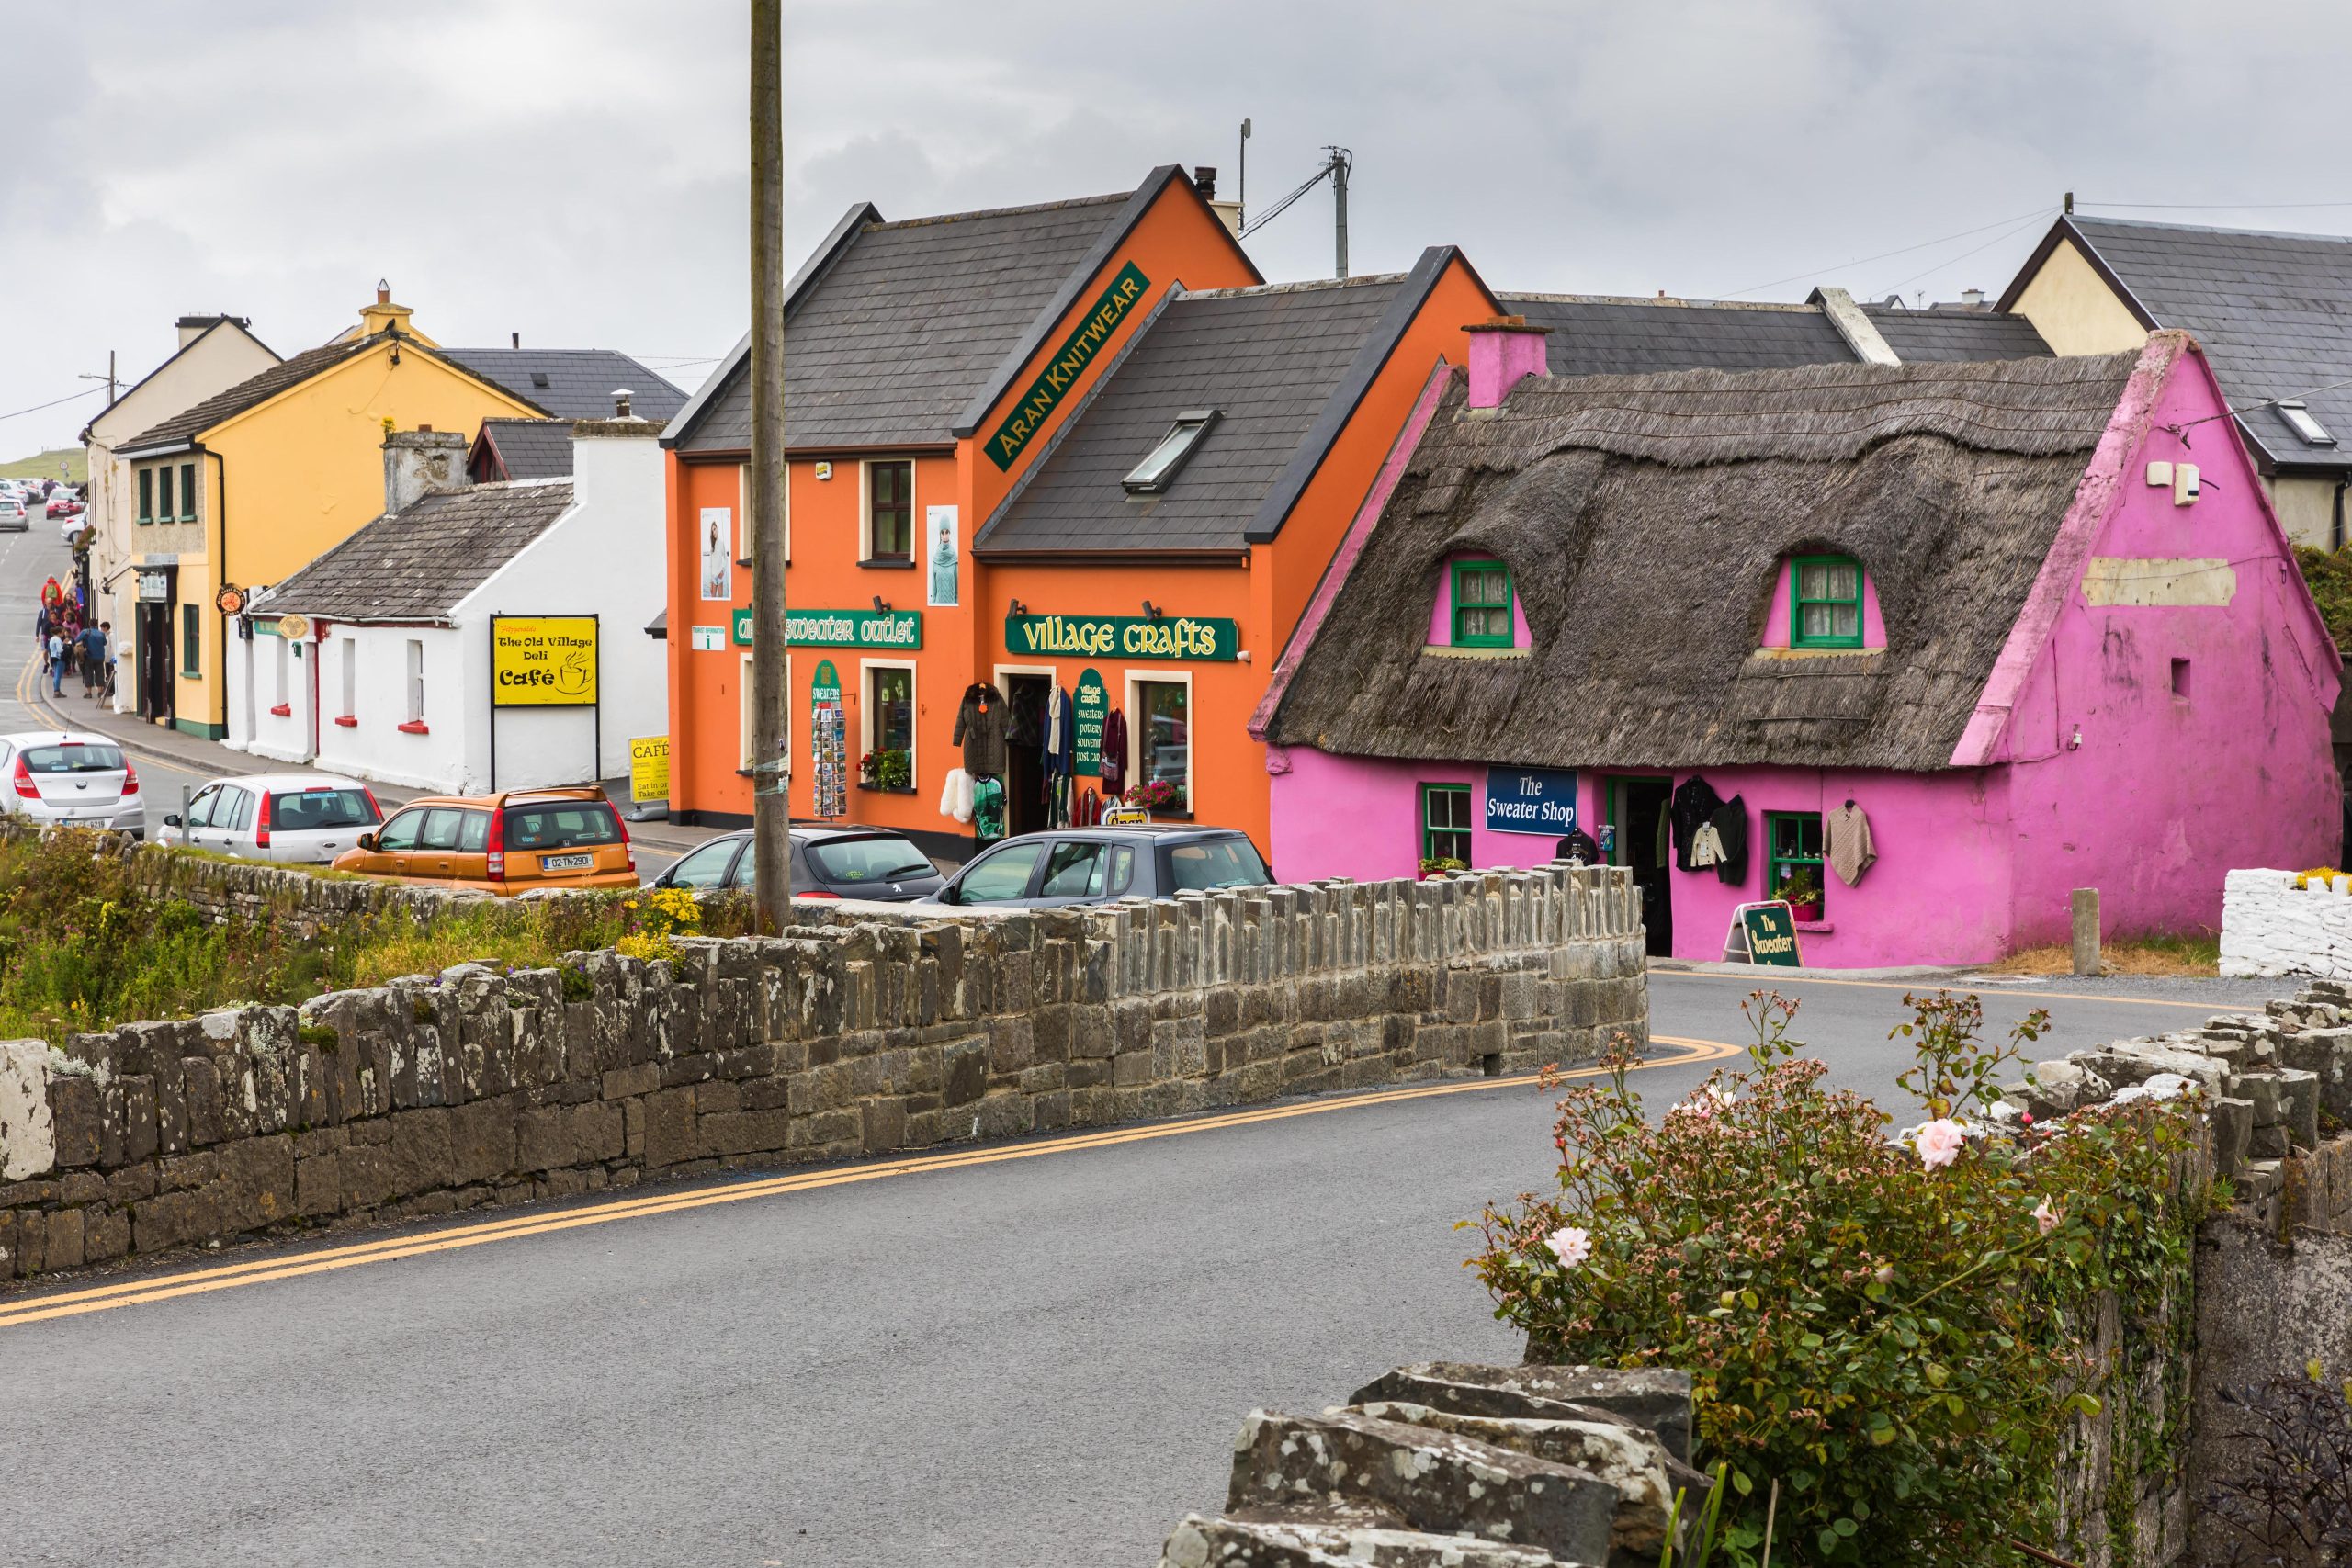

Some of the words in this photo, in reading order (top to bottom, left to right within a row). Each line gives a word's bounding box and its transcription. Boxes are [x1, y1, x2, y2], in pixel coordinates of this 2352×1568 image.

[999, 389, 1053, 458] ARAN
[1046, 277, 1140, 393] KNITWEAR
[497, 637, 522, 647] The
[523, 637, 544, 647] Old
[548, 637, 593, 649] Village
[523, 650, 548, 660] Deli
[499, 668, 555, 687] Café
[633, 741, 670, 759] CAFÉ
[1090, 752, 1101, 762] car
[1519, 775, 1543, 796] The
[1487, 798, 1539, 819] Sweater
[1541, 800, 1575, 828] Shop
[1760, 914, 1777, 932] The
[1751, 929, 1793, 955] Sweater
